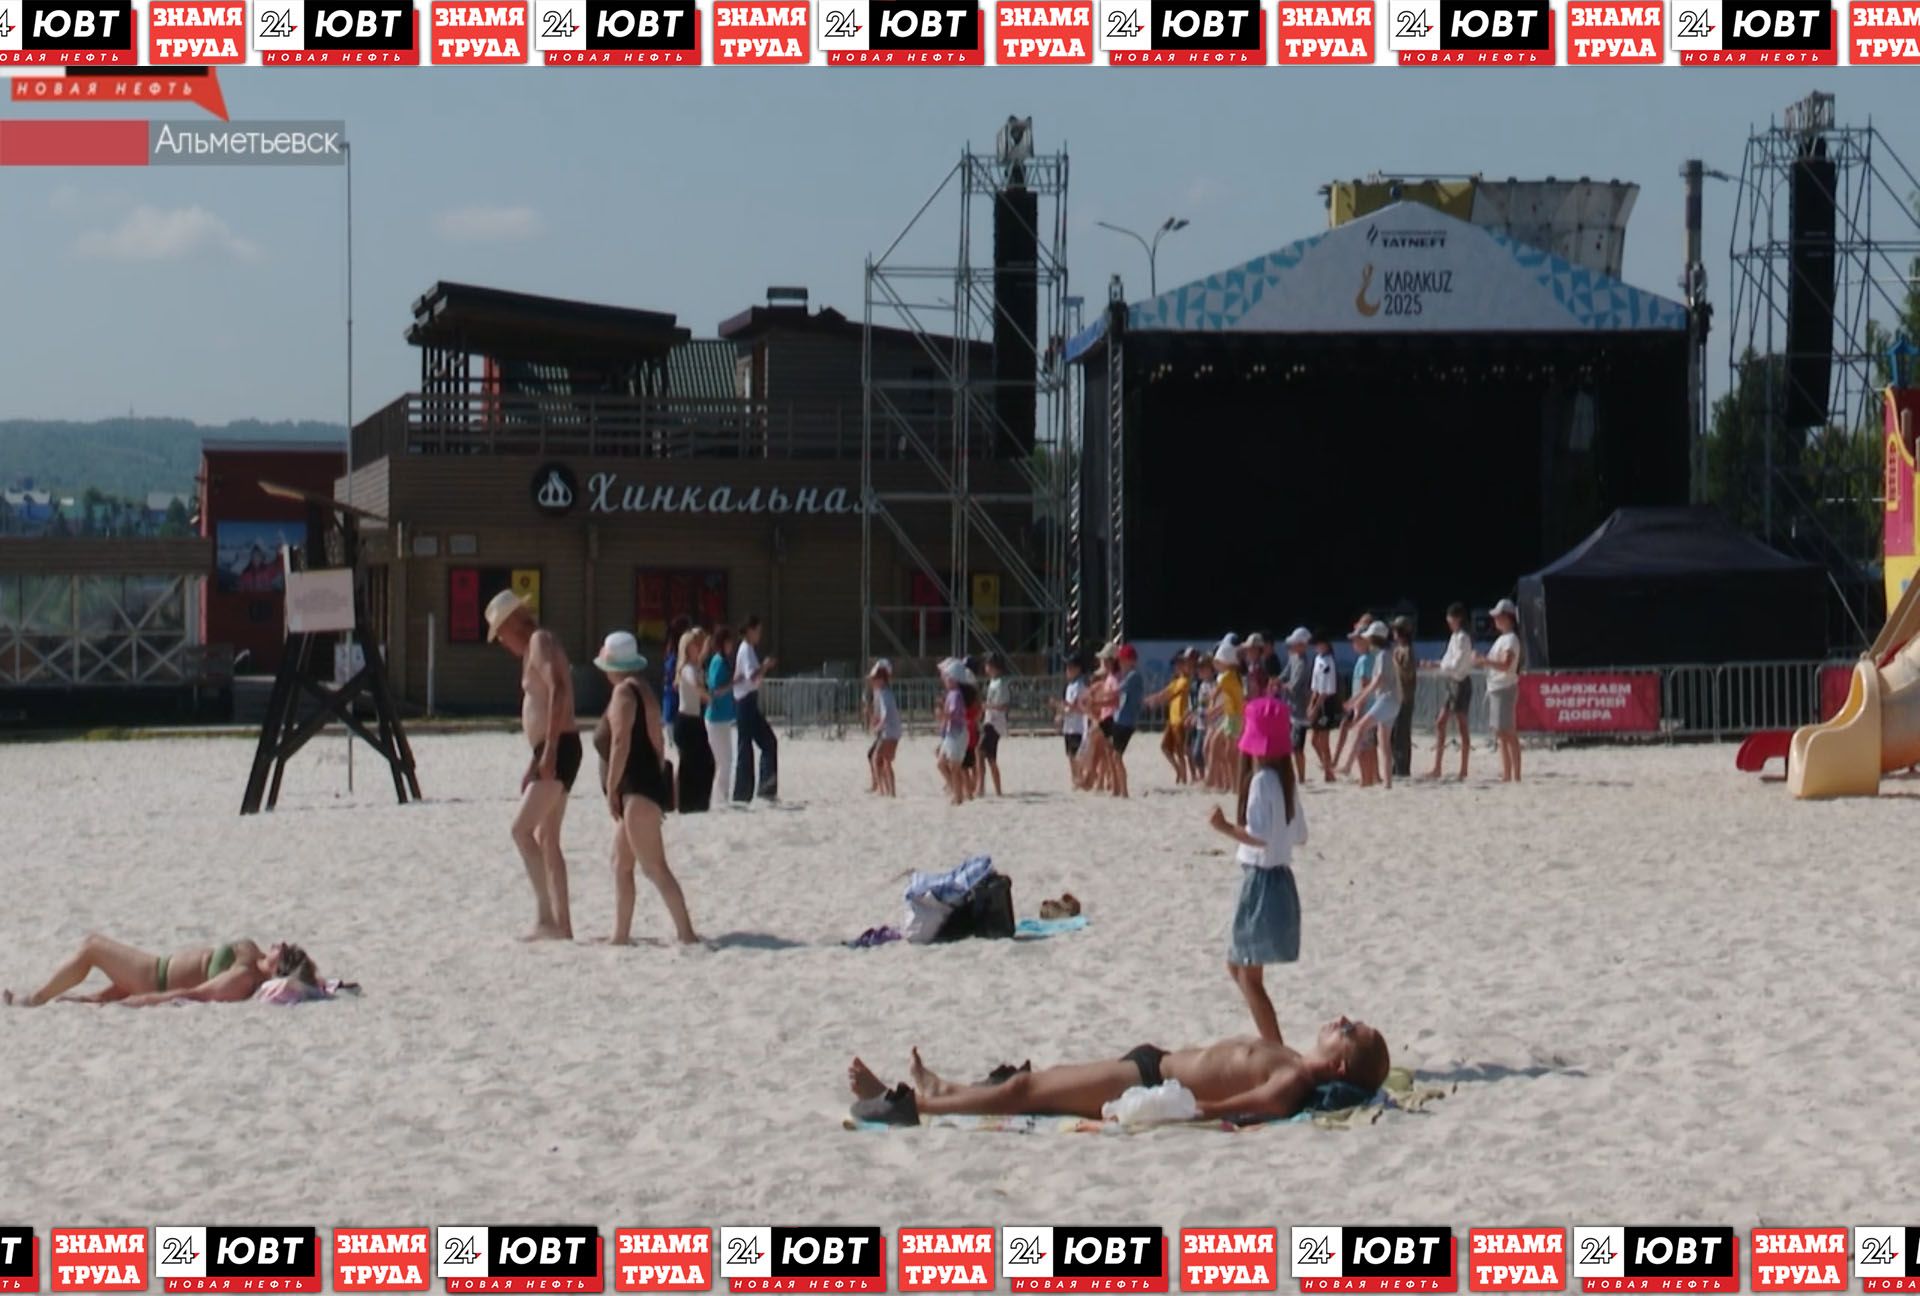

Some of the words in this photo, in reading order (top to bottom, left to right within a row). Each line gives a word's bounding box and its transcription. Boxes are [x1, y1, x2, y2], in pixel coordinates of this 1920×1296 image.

[1384, 271, 1453, 293] KARAKUZ
[1384, 295, 1423, 315] 2025
[1540, 683, 1631, 694] ЗАРЯЖАЕМ
[1545, 696, 1626, 708] ЭНЕРГИЕЙ
[1558, 709, 1612, 721] ДОБРА
